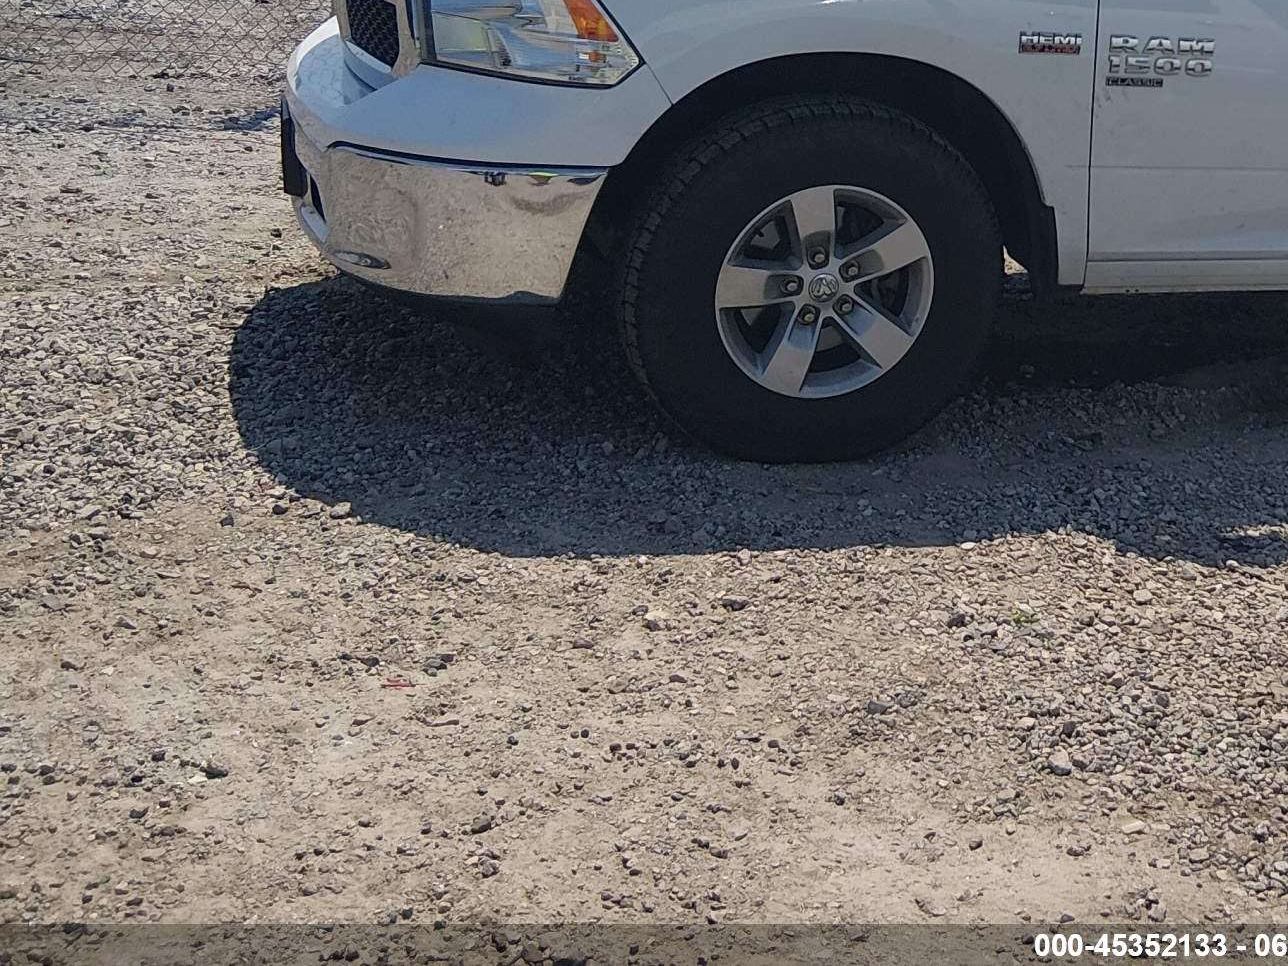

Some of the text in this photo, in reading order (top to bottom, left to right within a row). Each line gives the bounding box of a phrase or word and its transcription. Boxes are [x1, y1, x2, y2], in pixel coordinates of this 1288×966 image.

[1020, 32, 1082, 45] HEMI
[1109, 35, 1215, 56] RAM
[1108, 56, 1213, 77] 1500
